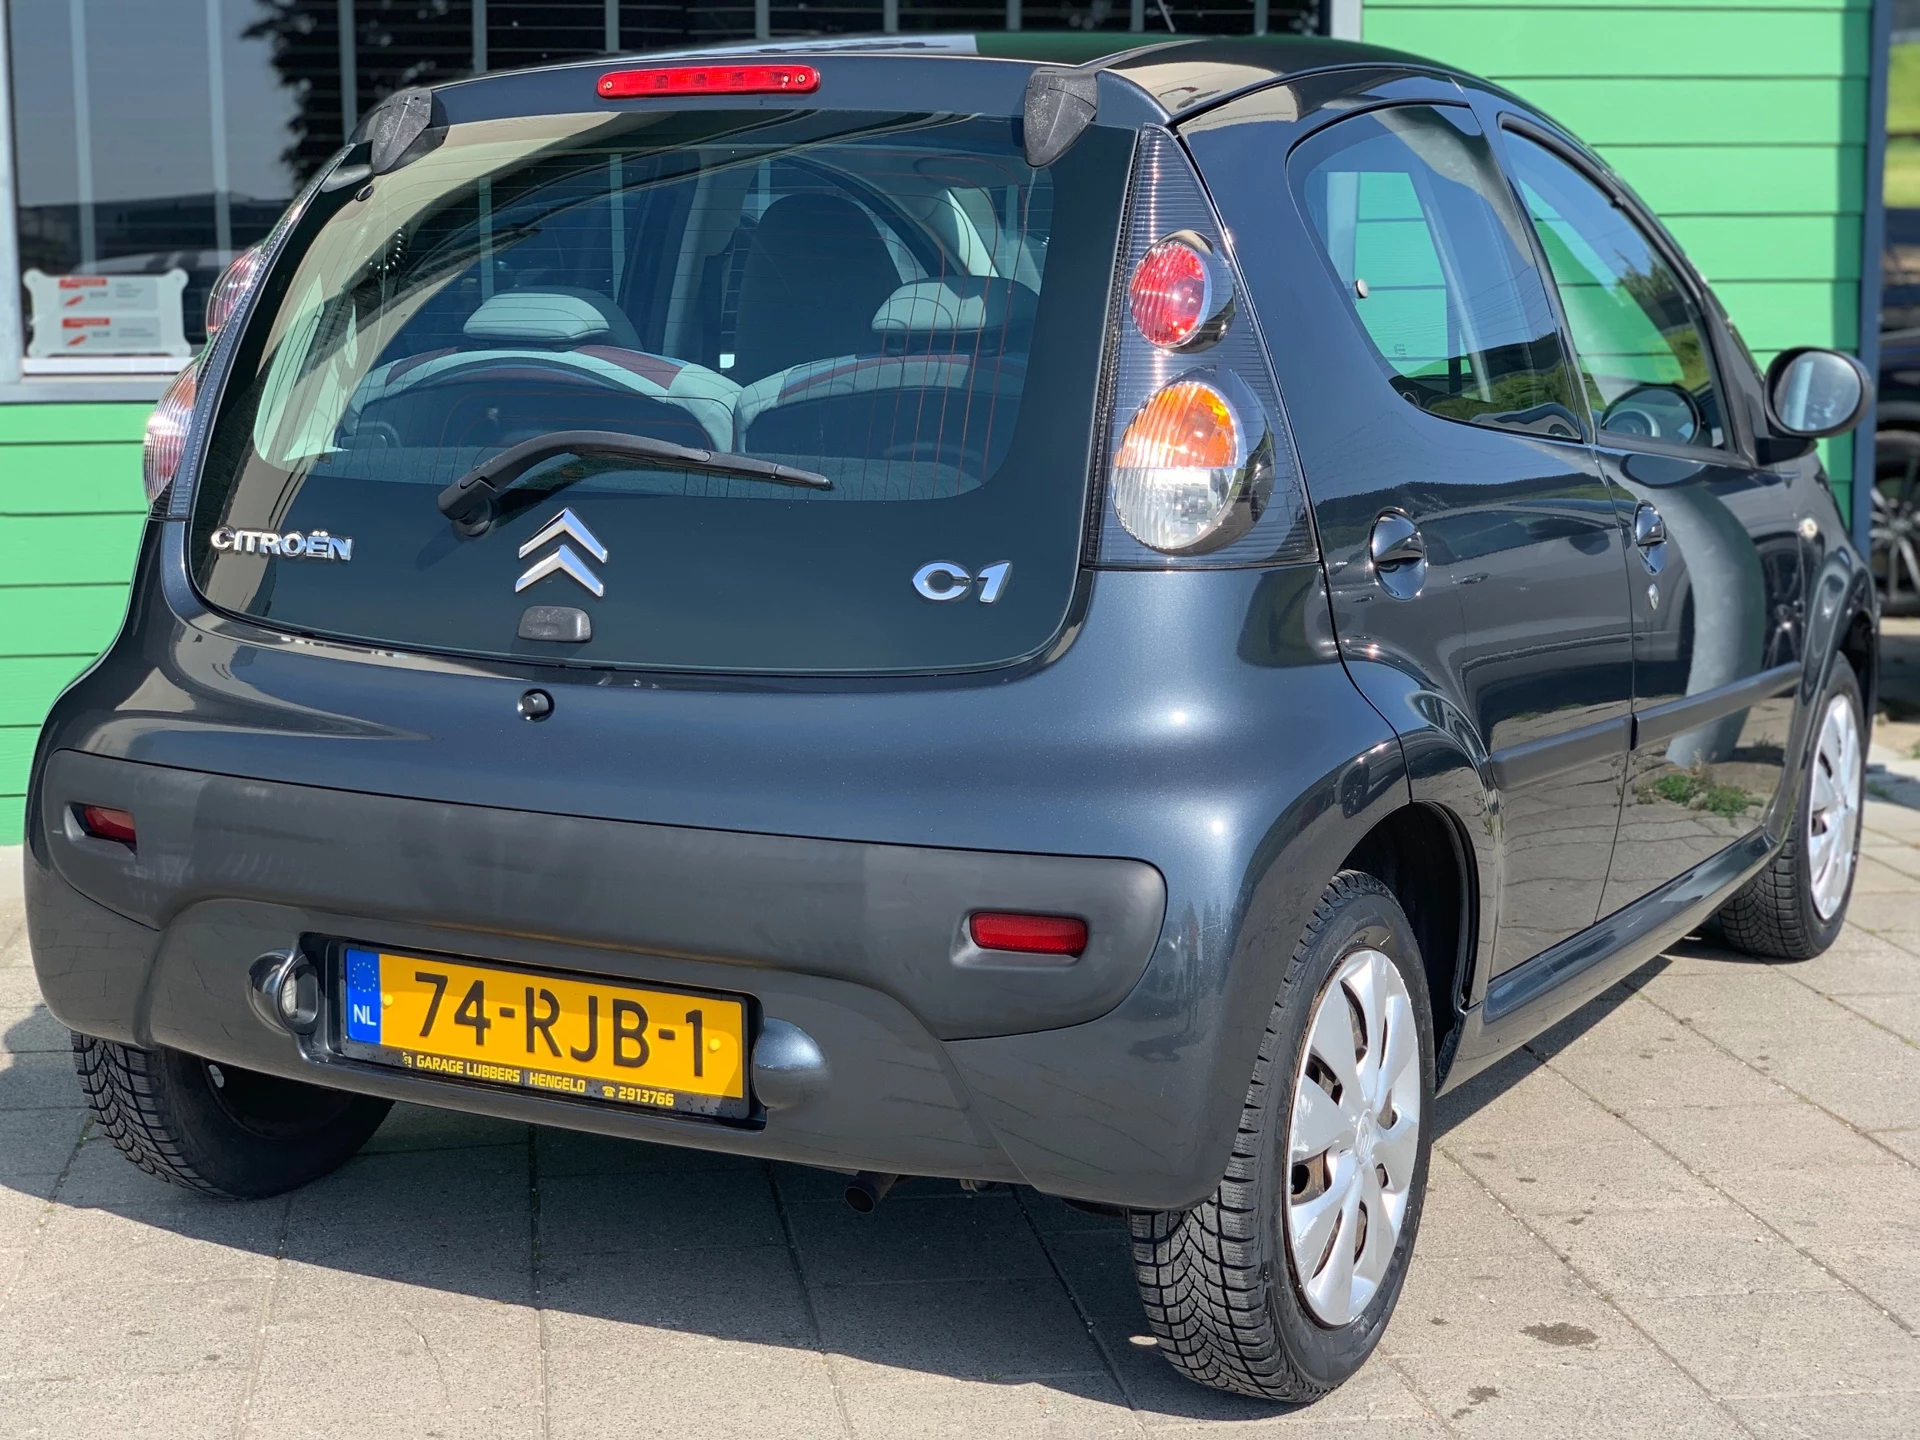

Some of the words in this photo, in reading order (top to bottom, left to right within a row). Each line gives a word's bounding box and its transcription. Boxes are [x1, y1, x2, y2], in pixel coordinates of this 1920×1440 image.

[211, 527, 353, 561] CITROËN
[911, 560, 1012, 604] C1
[353, 1003, 377, 1026] NL
[414, 971, 704, 1078] 74-RJB-1
[416, 1054, 464, 1074] GARAGE
[466, 1062, 521, 1083] LUBBERS
[529, 1071, 586, 1093] HENGELO
[618, 1086, 675, 1107] 2913766
